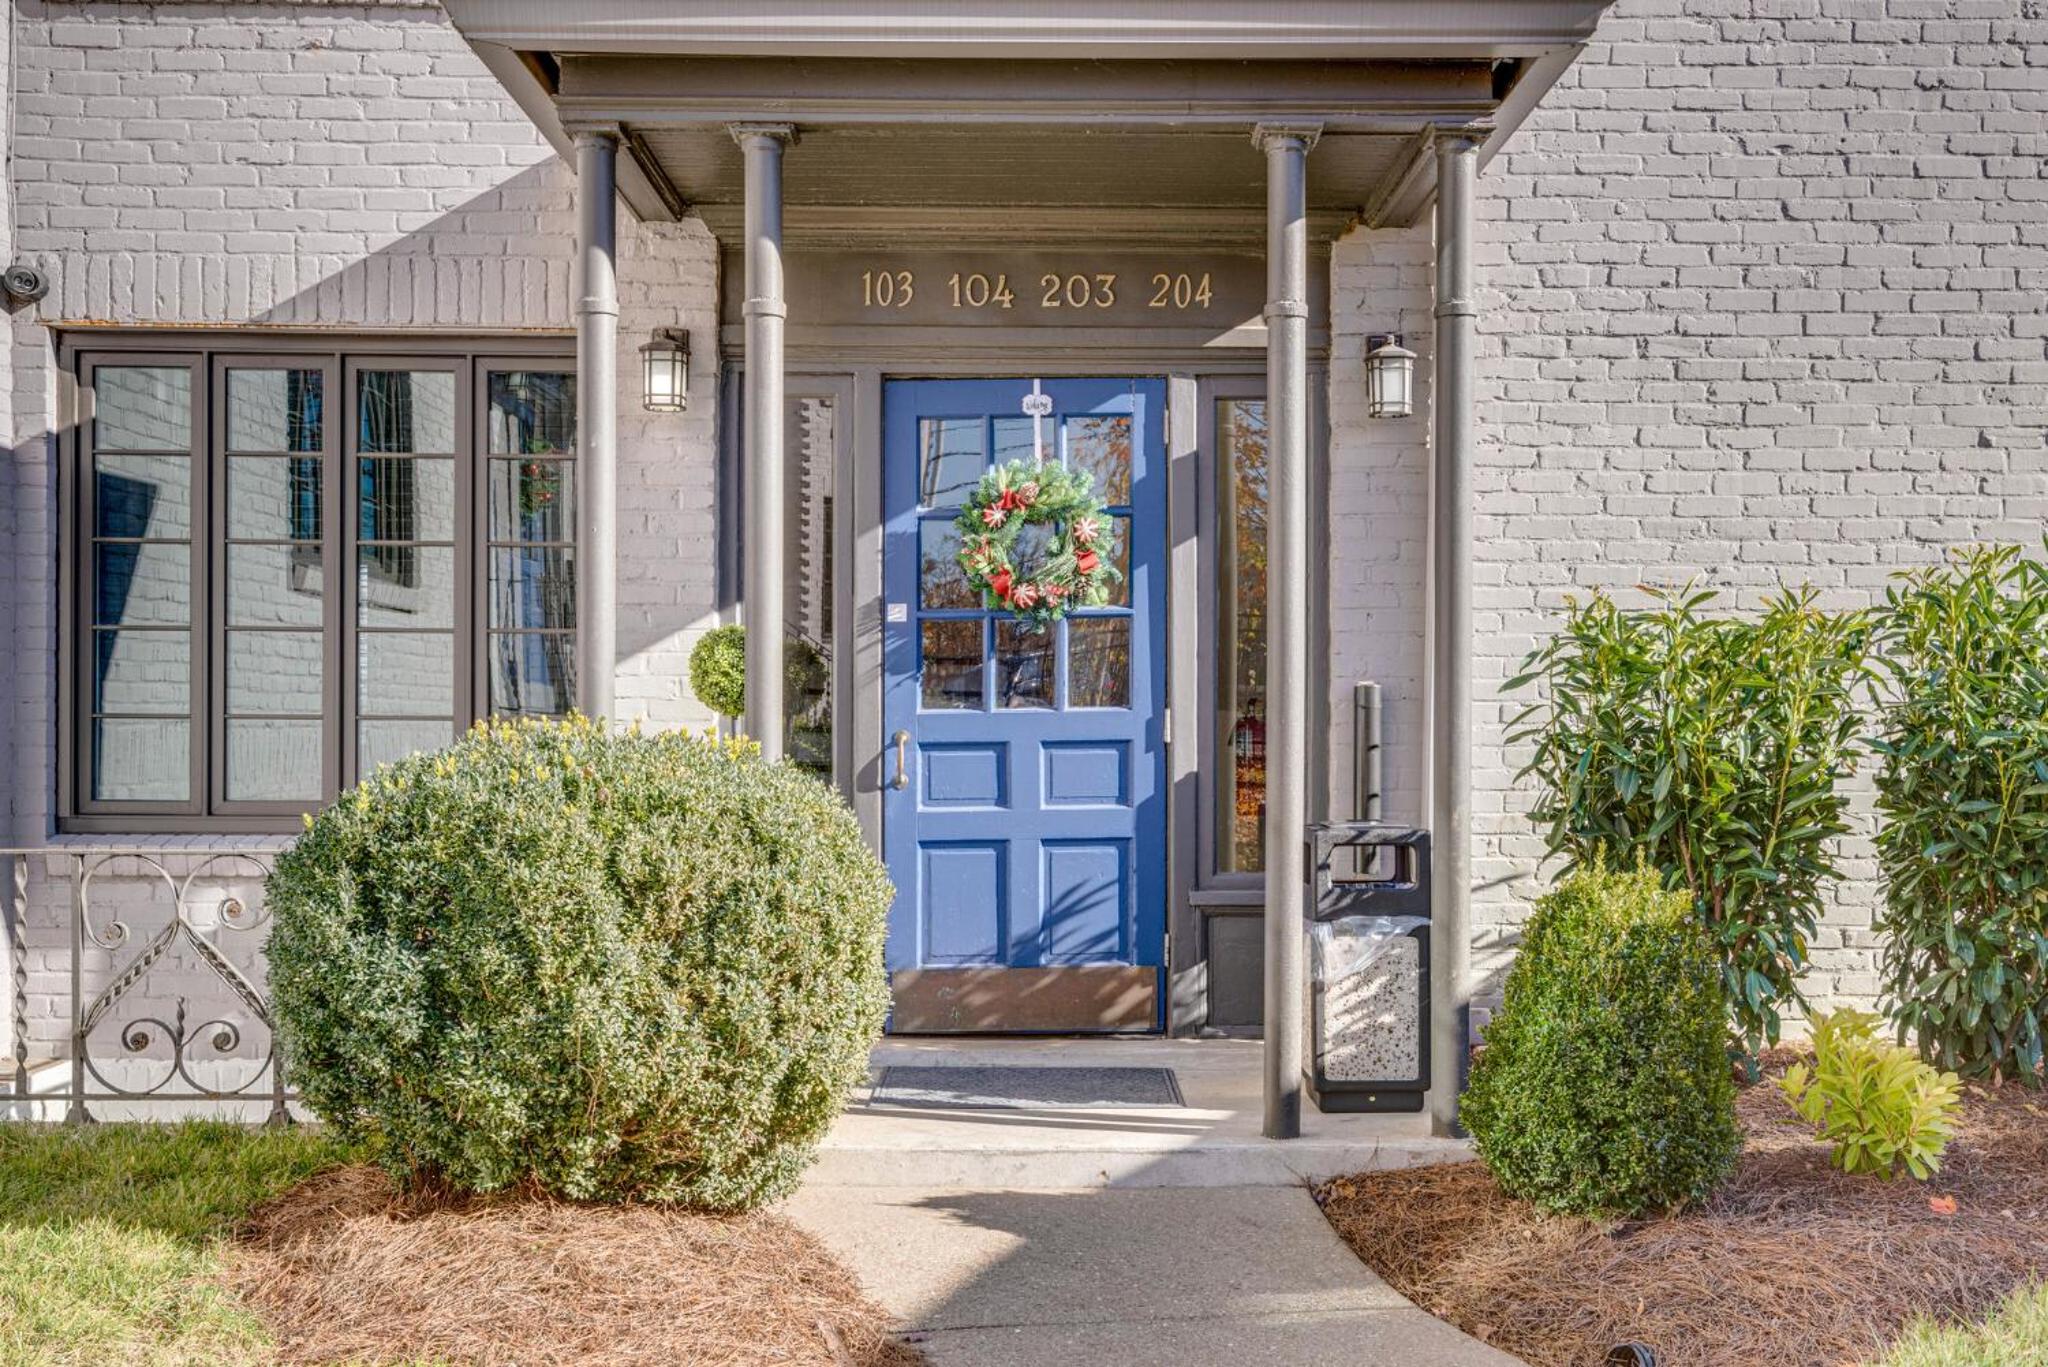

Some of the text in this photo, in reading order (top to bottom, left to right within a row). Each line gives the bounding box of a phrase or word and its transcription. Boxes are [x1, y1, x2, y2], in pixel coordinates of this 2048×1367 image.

[862, 270, 1213, 309] 103 104 203 204
